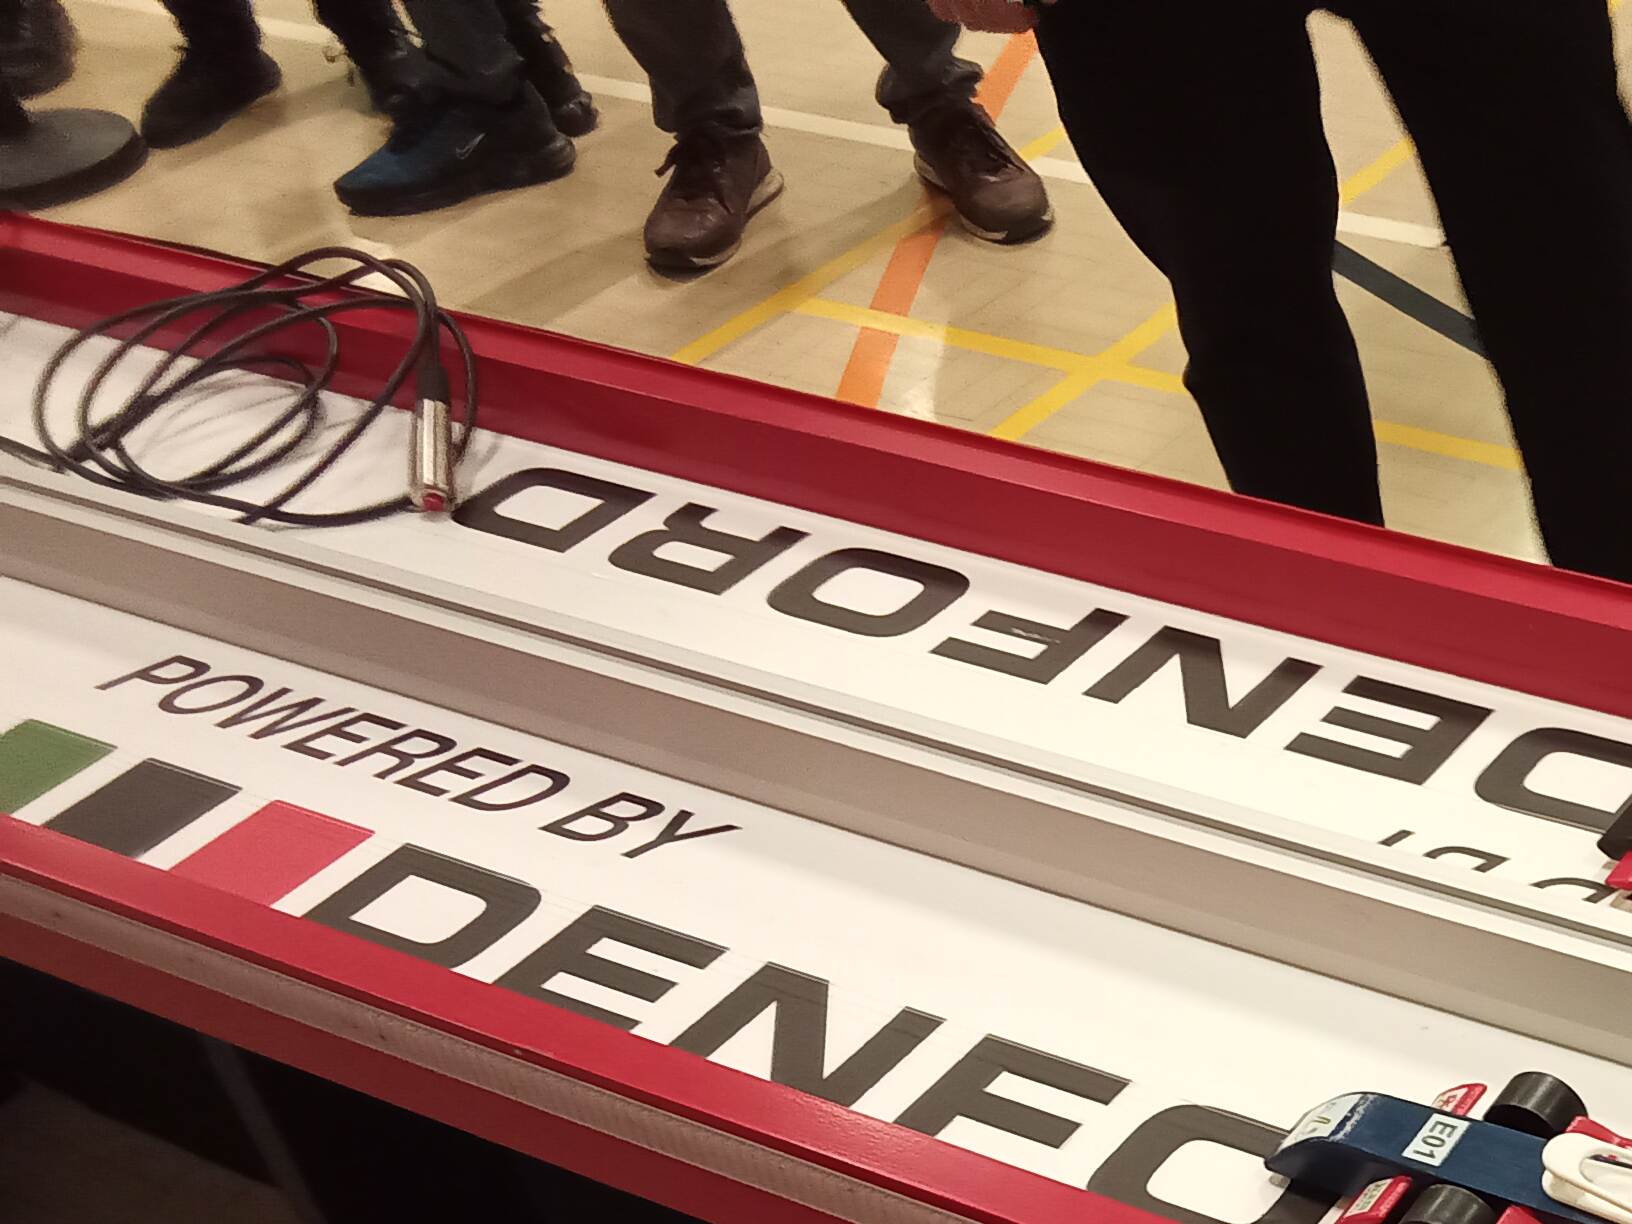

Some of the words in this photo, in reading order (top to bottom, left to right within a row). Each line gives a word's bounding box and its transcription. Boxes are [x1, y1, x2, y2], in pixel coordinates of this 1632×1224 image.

[95, 654, 571, 812] POWERED
[538, 791, 743, 858] BY
[1412, 1120, 1458, 1160] E01
